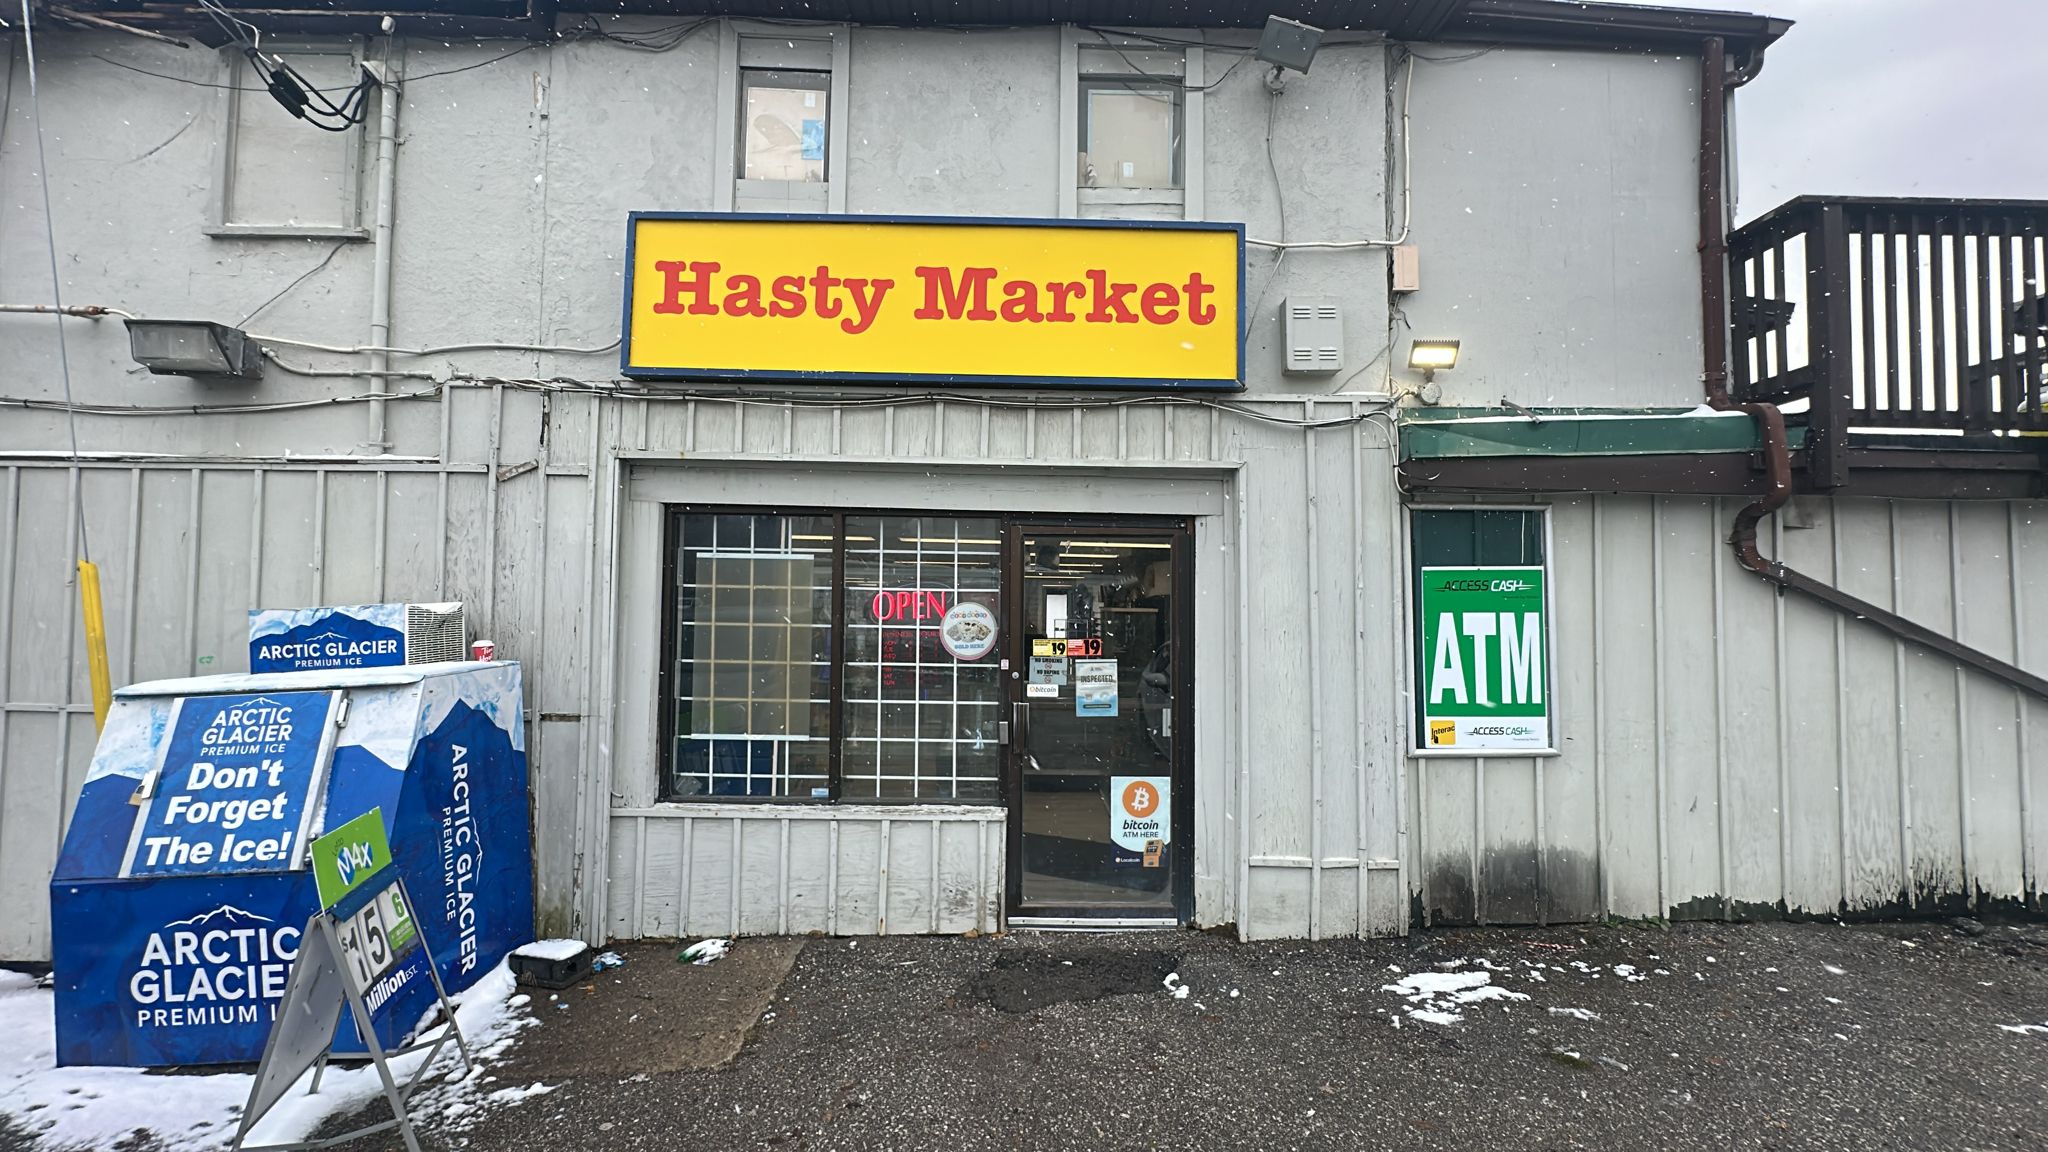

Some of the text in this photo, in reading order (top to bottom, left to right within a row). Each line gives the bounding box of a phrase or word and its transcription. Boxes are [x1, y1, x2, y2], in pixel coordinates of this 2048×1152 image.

[653, 260, 1217, 335] Hasty Market
[1443, 579, 1524, 592] ACCESS CASH
[872, 591, 946, 621] OPEN
[258, 639, 398, 661] ARCTIC GLACIER
[1051, 642, 1066, 655] 19
[1083, 639, 1101, 655] 19
[1429, 612, 1542, 704] ATM
[295, 657, 362, 668] PREMIUM ICE
[1080, 675, 1113, 683] INSPECTED
[211, 707, 293, 727] ARCTIC
[202, 724, 293, 745] GLACIER
[1431, 724, 1455, 740] Interac
[1472, 726, 1528, 736] ACCESS CASH
[200, 743, 287, 756] PREMIUM ICE
[186, 759, 285, 791] Don't
[164, 792, 288, 829] Forget
[1122, 819, 1159, 830] bitcoin
[144, 831, 293, 866] The Ice!
[451, 743, 478, 976] ARCTIC GLACIER
[337, 842, 373, 886] MAX
[442, 806, 456, 922] PREMIUM ICE
[391, 892, 405, 918] 6
[140, 926, 301, 967] ARCTIC
[130, 964, 294, 1004] GLACIE
[365, 967, 407, 1016] Million
[138, 1004, 258, 1028] PREMIUM
